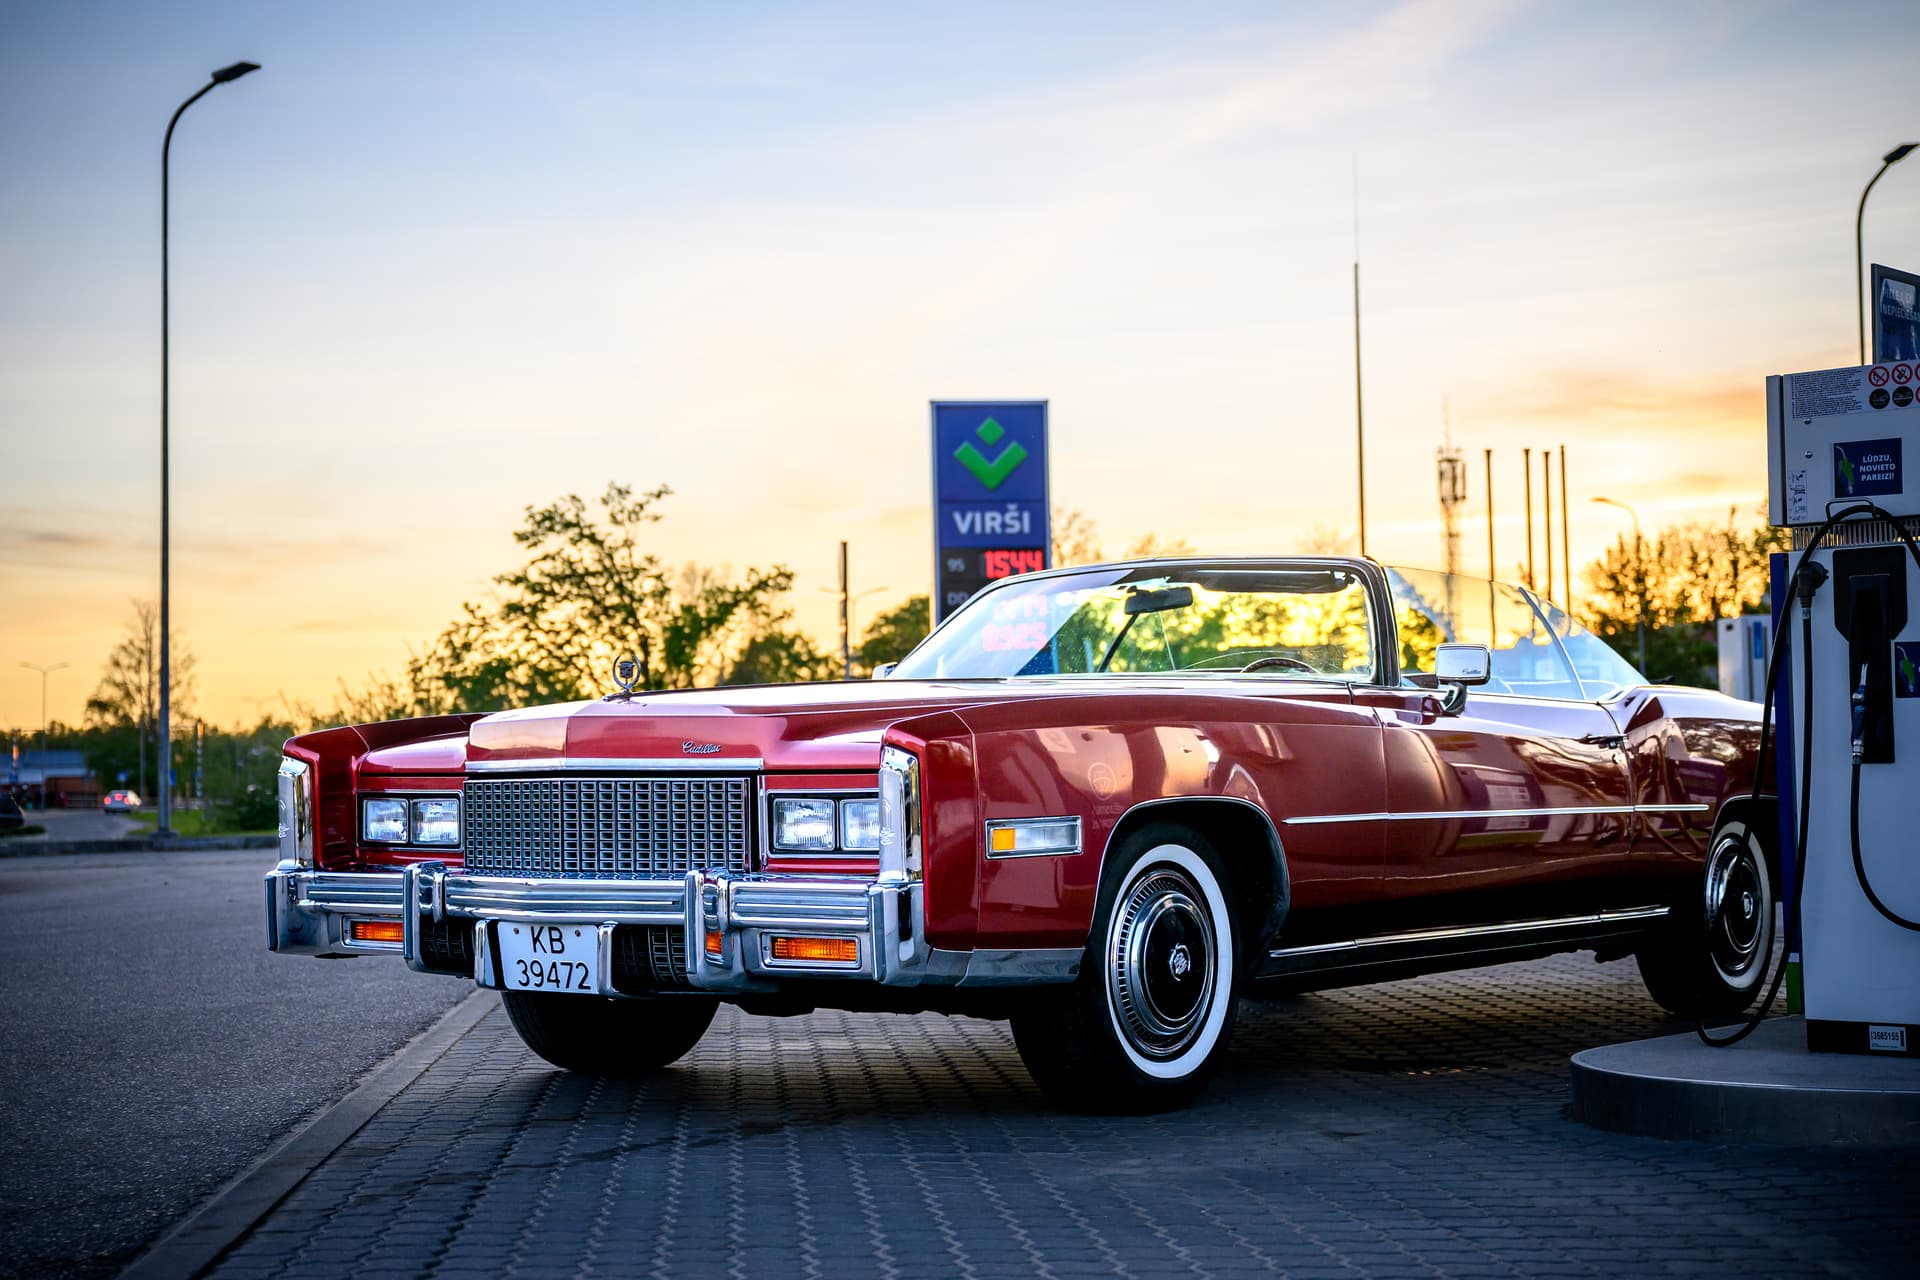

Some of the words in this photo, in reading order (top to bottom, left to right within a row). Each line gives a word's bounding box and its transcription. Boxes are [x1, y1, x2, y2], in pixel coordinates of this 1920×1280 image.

[1859, 463, 1896, 473] NOVIETO
[953, 503, 1031, 535] VIRŠI
[946, 557, 966, 573] 95
[984, 550, 1043, 579] 1544
[682, 740, 722, 754] Cadillac
[530, 925, 566, 955] KB
[516, 958, 592, 990] 39472
